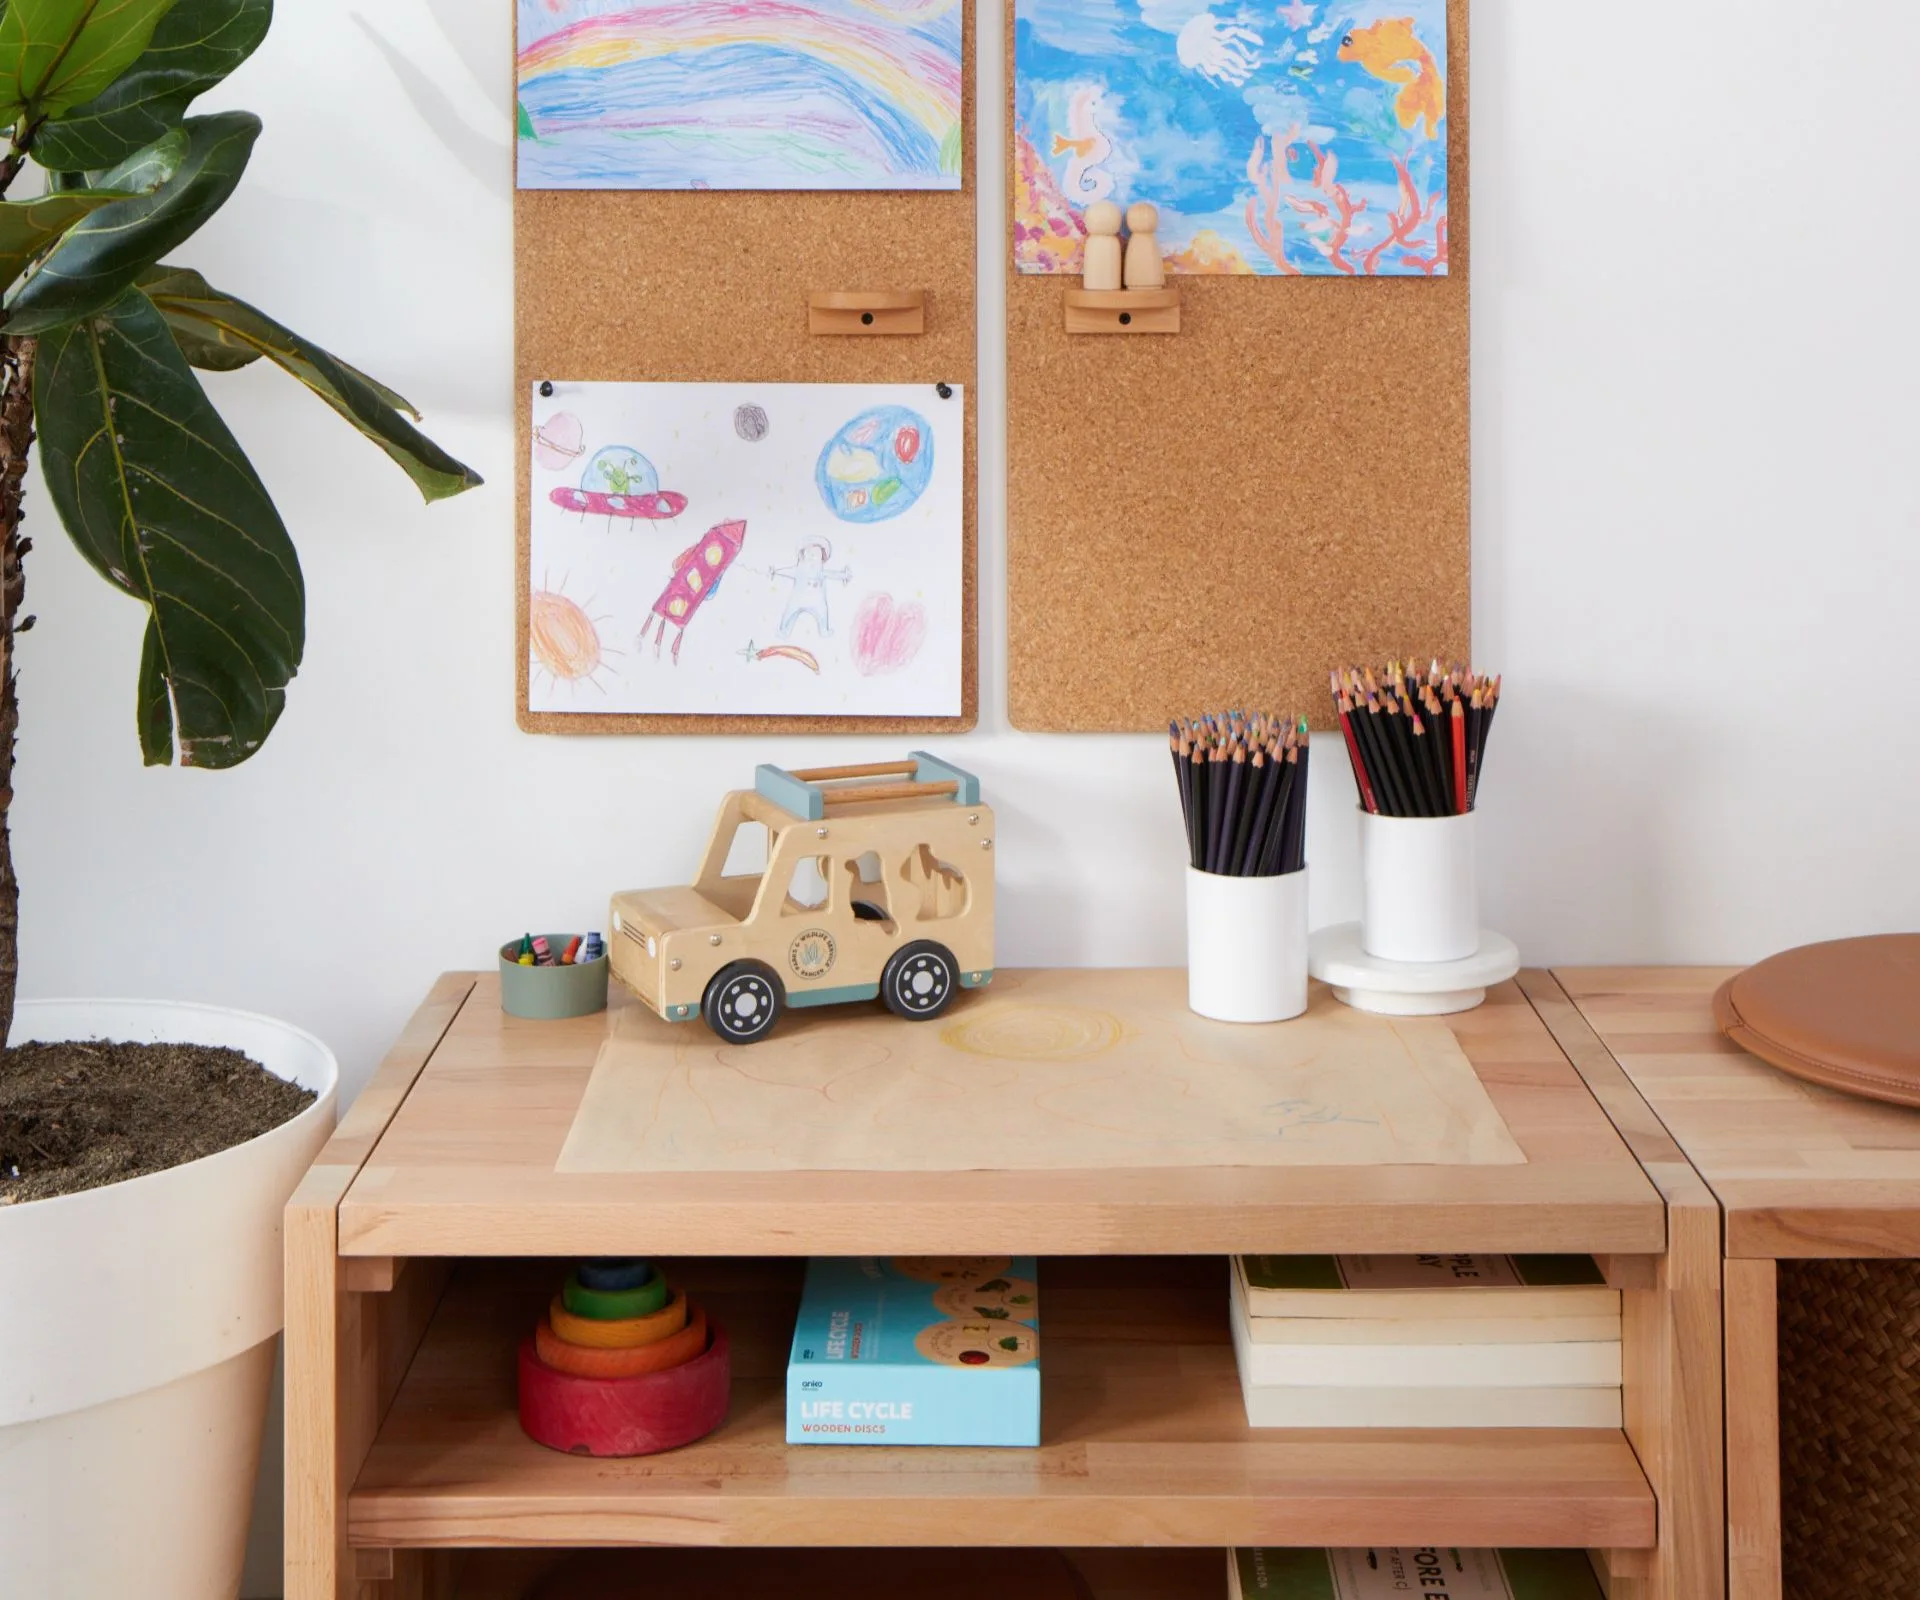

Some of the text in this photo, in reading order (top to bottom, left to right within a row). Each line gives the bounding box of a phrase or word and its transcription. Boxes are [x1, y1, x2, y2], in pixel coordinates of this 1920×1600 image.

[1415, 1254, 1443, 1269] AY
[801, 1380, 823, 1388] anko
[801, 1401, 913, 1420] LIFE CYCLE
[802, 1424, 886, 1434] WOODEN DISCS
